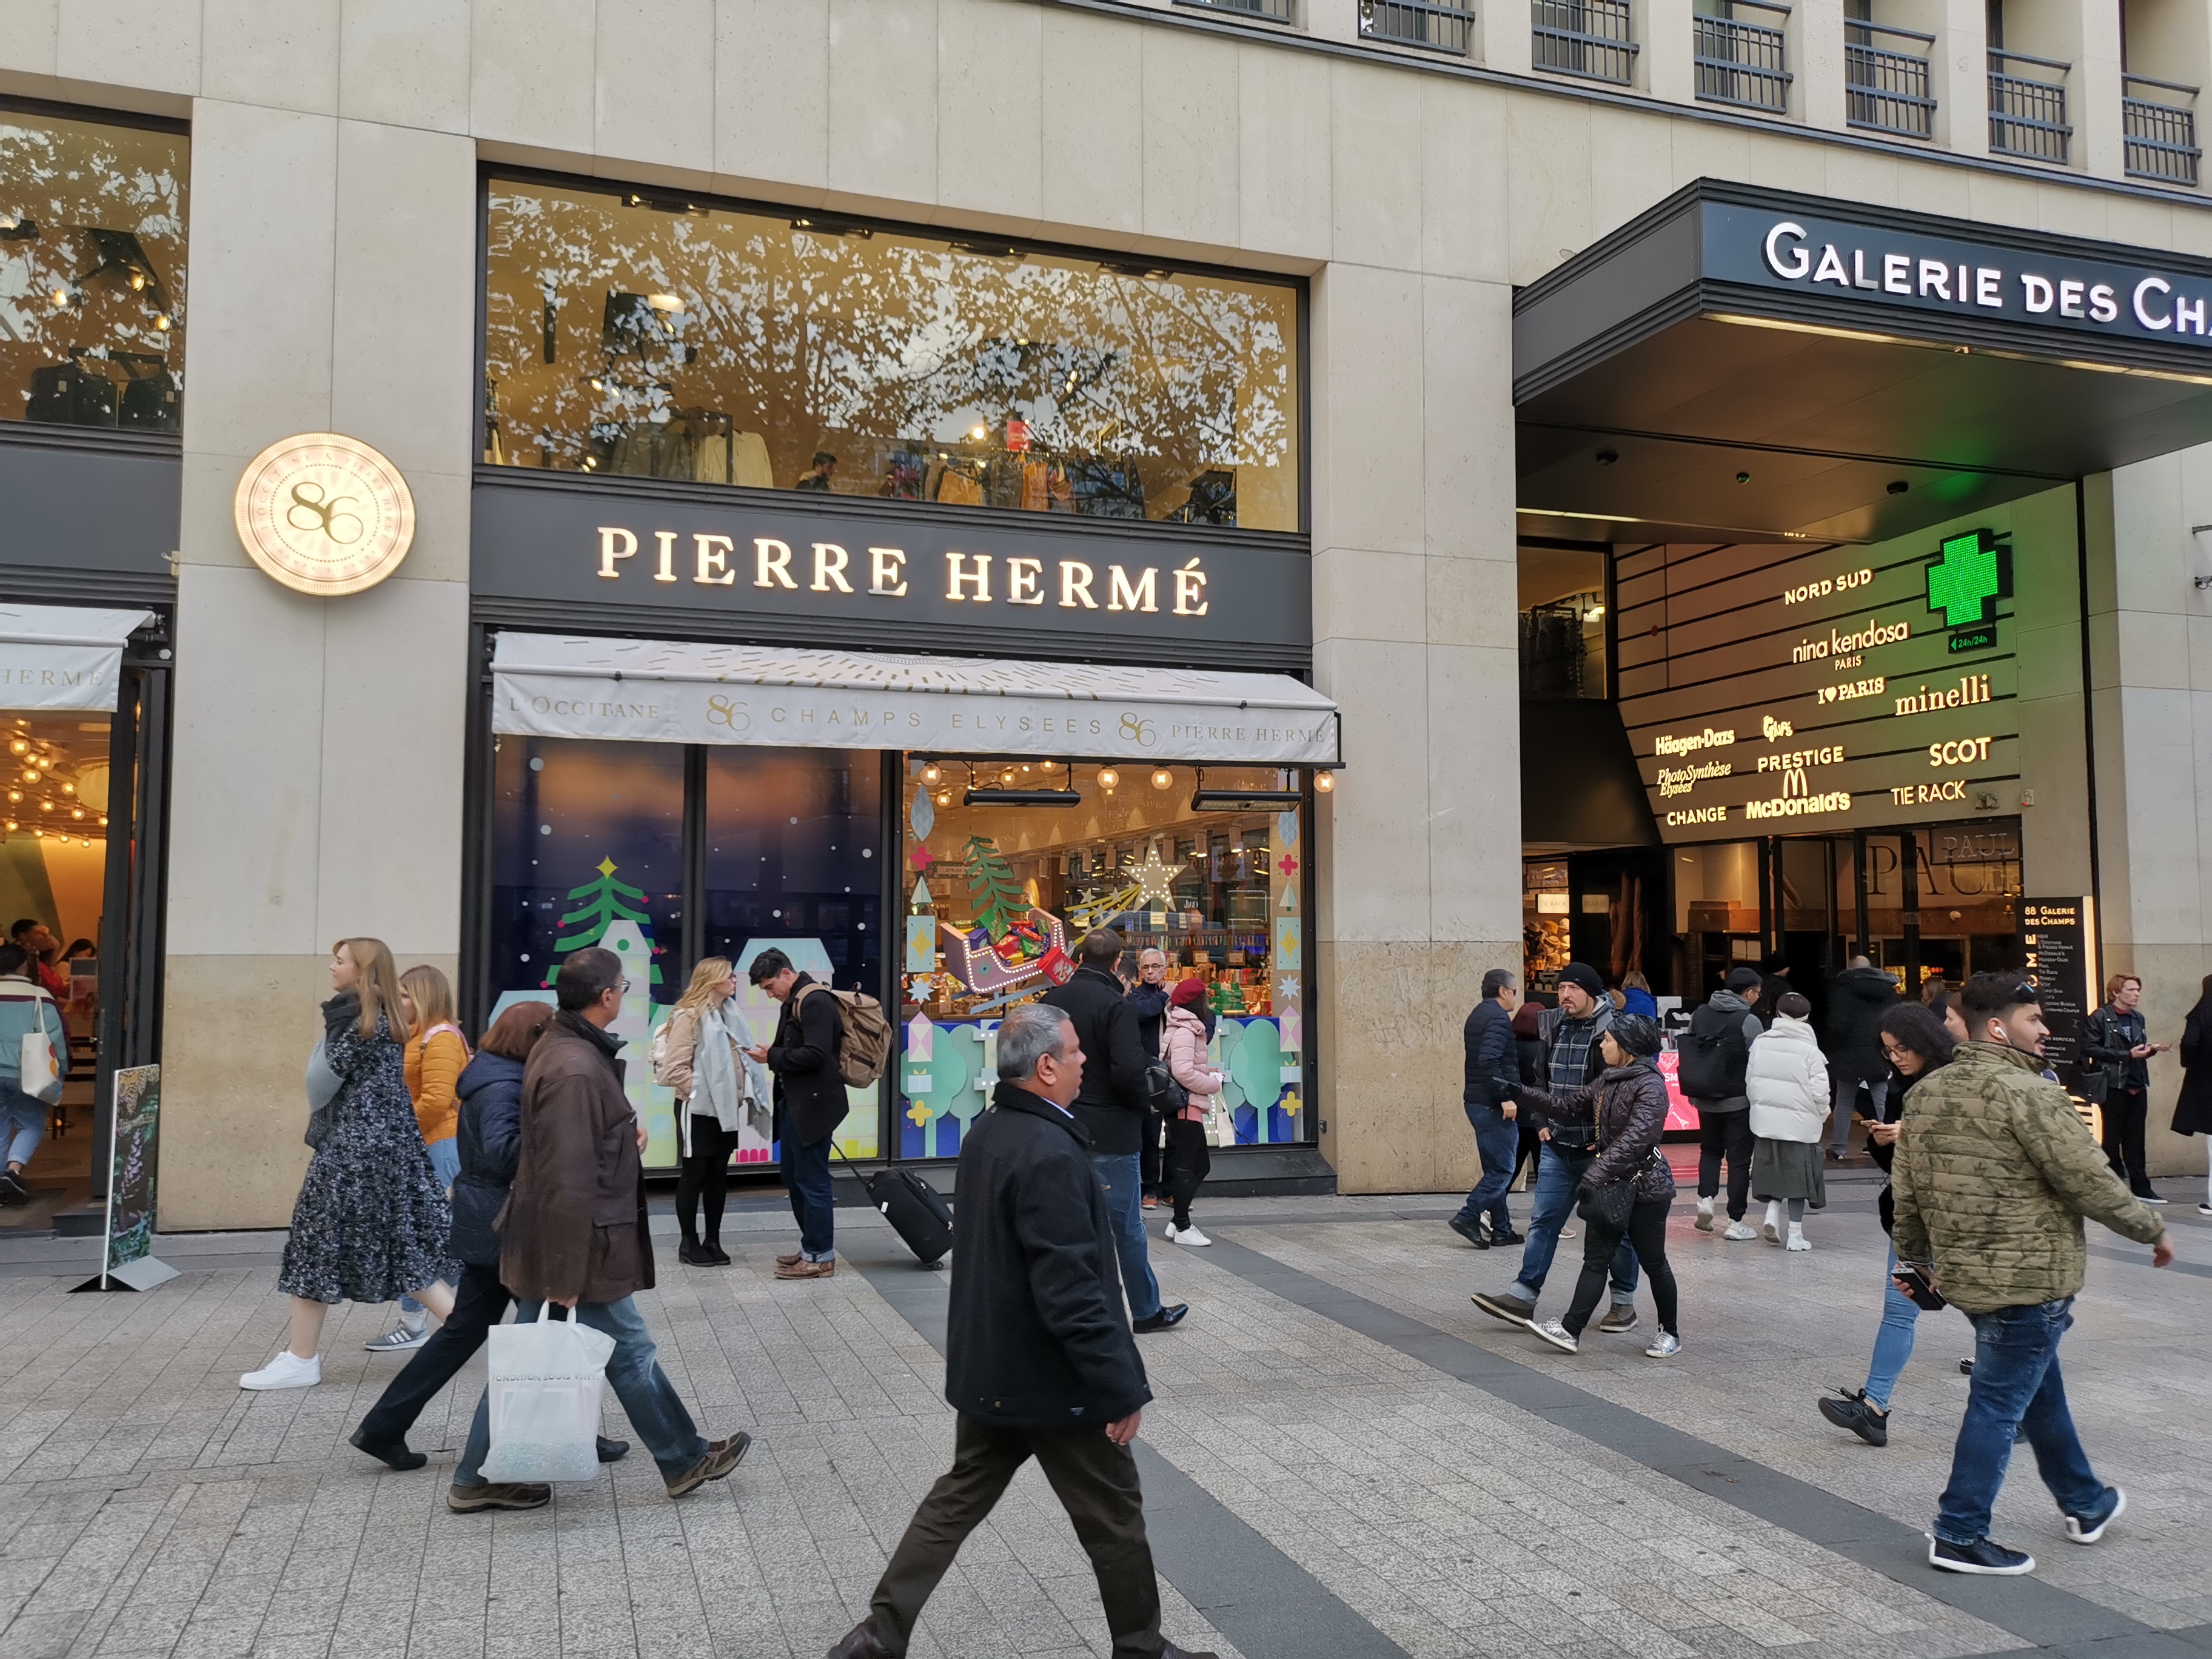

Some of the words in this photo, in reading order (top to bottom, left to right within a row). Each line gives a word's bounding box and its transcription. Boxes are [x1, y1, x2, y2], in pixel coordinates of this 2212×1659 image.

[1765, 221, 2003, 308] GALERIE
[2020, 273, 2117, 323] DES
[2133, 276, 2212, 337] CH
[287, 481, 364, 545] 86
[596, 526, 908, 597] PIERRE
[945, 556, 1210, 615] HERMÉ
[1785, 578, 1833, 606] NORD
[1835, 568, 1872, 592] SUD
[1792, 638, 1828, 665] nina
[1831, 619, 1909, 655] kendosa
[1958, 634, 1988, 649] 24h/24h
[1834, 654, 1862, 671] PARIS
[1837, 676, 1885, 701] PARIS
[1895, 675, 1991, 717] minelli
[706, 694, 751, 731] 86
[771, 706, 921, 728] CHAMPS
[951, 713, 1101, 735] ELYSEES
[1118, 712, 1156, 747] 86
[1171, 725, 1246, 741] PIERRE
[1655, 728, 1735, 757] Häagen-Dazs
[1929, 737, 1992, 768] SCOT
[1758, 745, 1845, 774] PRESTIGE
[1745, 792, 1851, 820] McDonald's
[1891, 786, 1914, 806] TIE
[1917, 780, 1966, 804] RACK
[1666, 806, 1728, 826] CHANGE
[1943, 833, 2015, 859] PAUL
[2025, 907, 2037, 915] 88
[2040, 906, 2076, 915] GALERIE
[2040, 916, 2076, 925] CHAMPS
